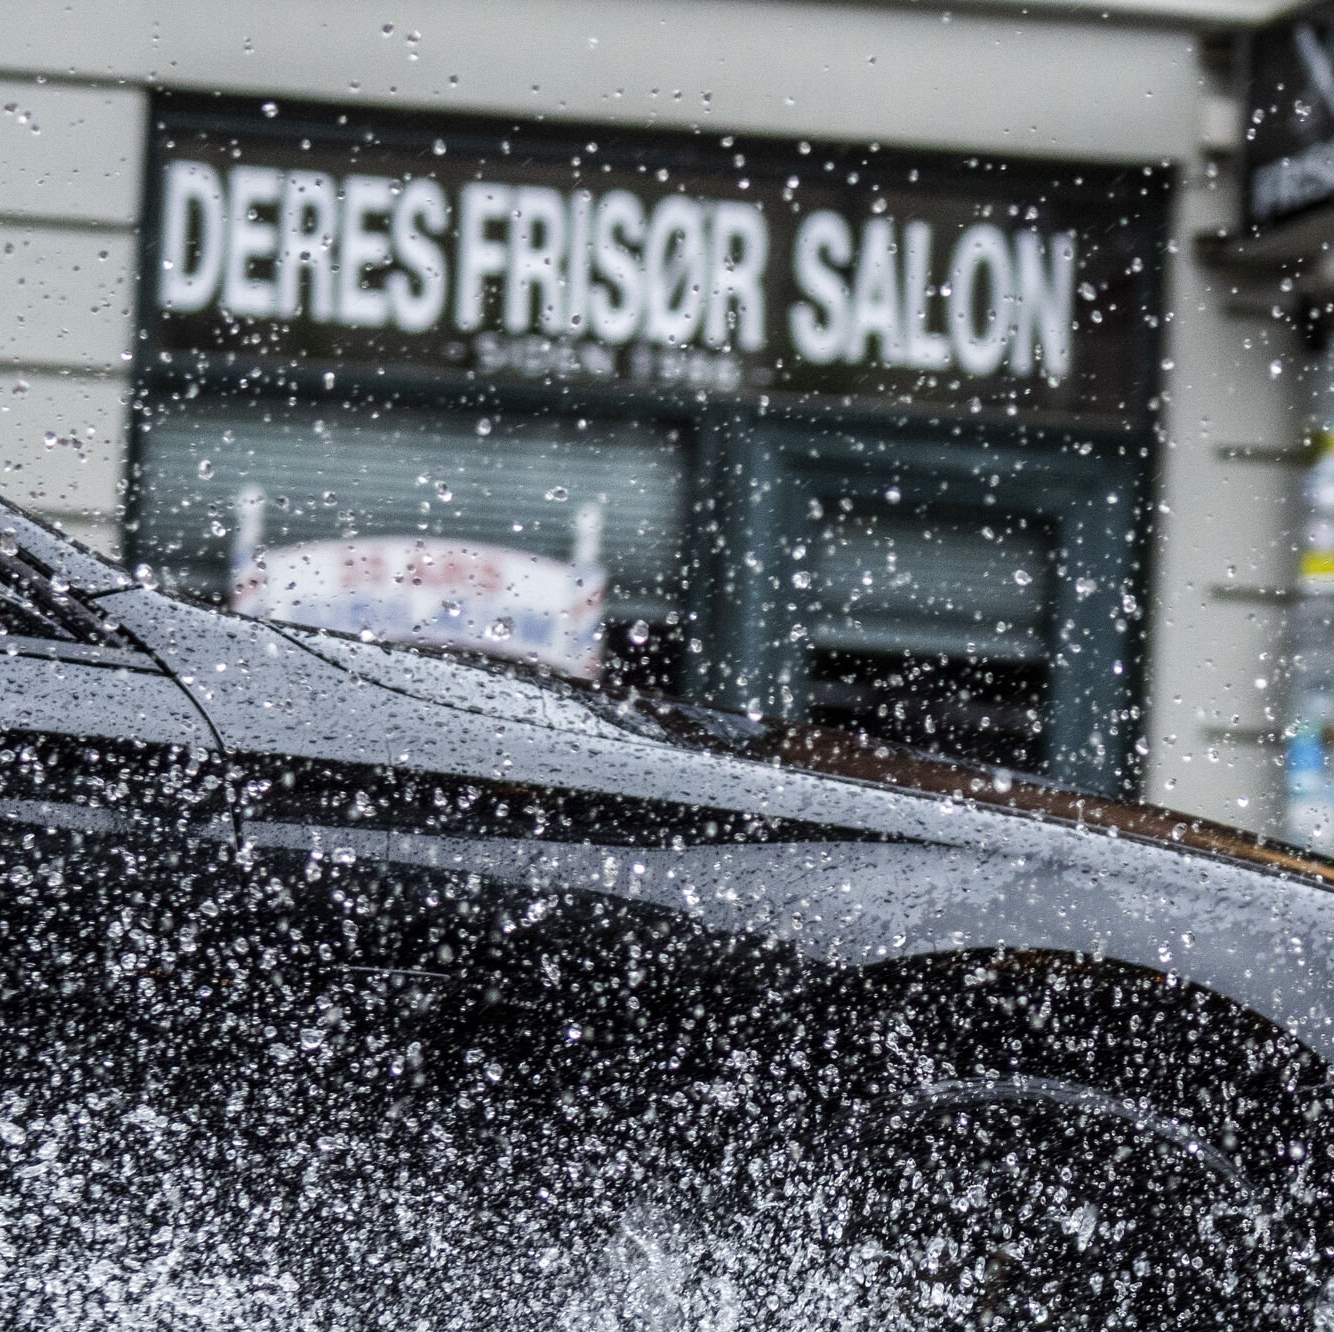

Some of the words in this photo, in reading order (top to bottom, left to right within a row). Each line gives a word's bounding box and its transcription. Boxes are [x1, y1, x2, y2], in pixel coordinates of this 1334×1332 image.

[158, 159, 449, 334] DERES
[455, 181, 769, 352] FRISØR
[787, 209, 1075, 378] SALON
